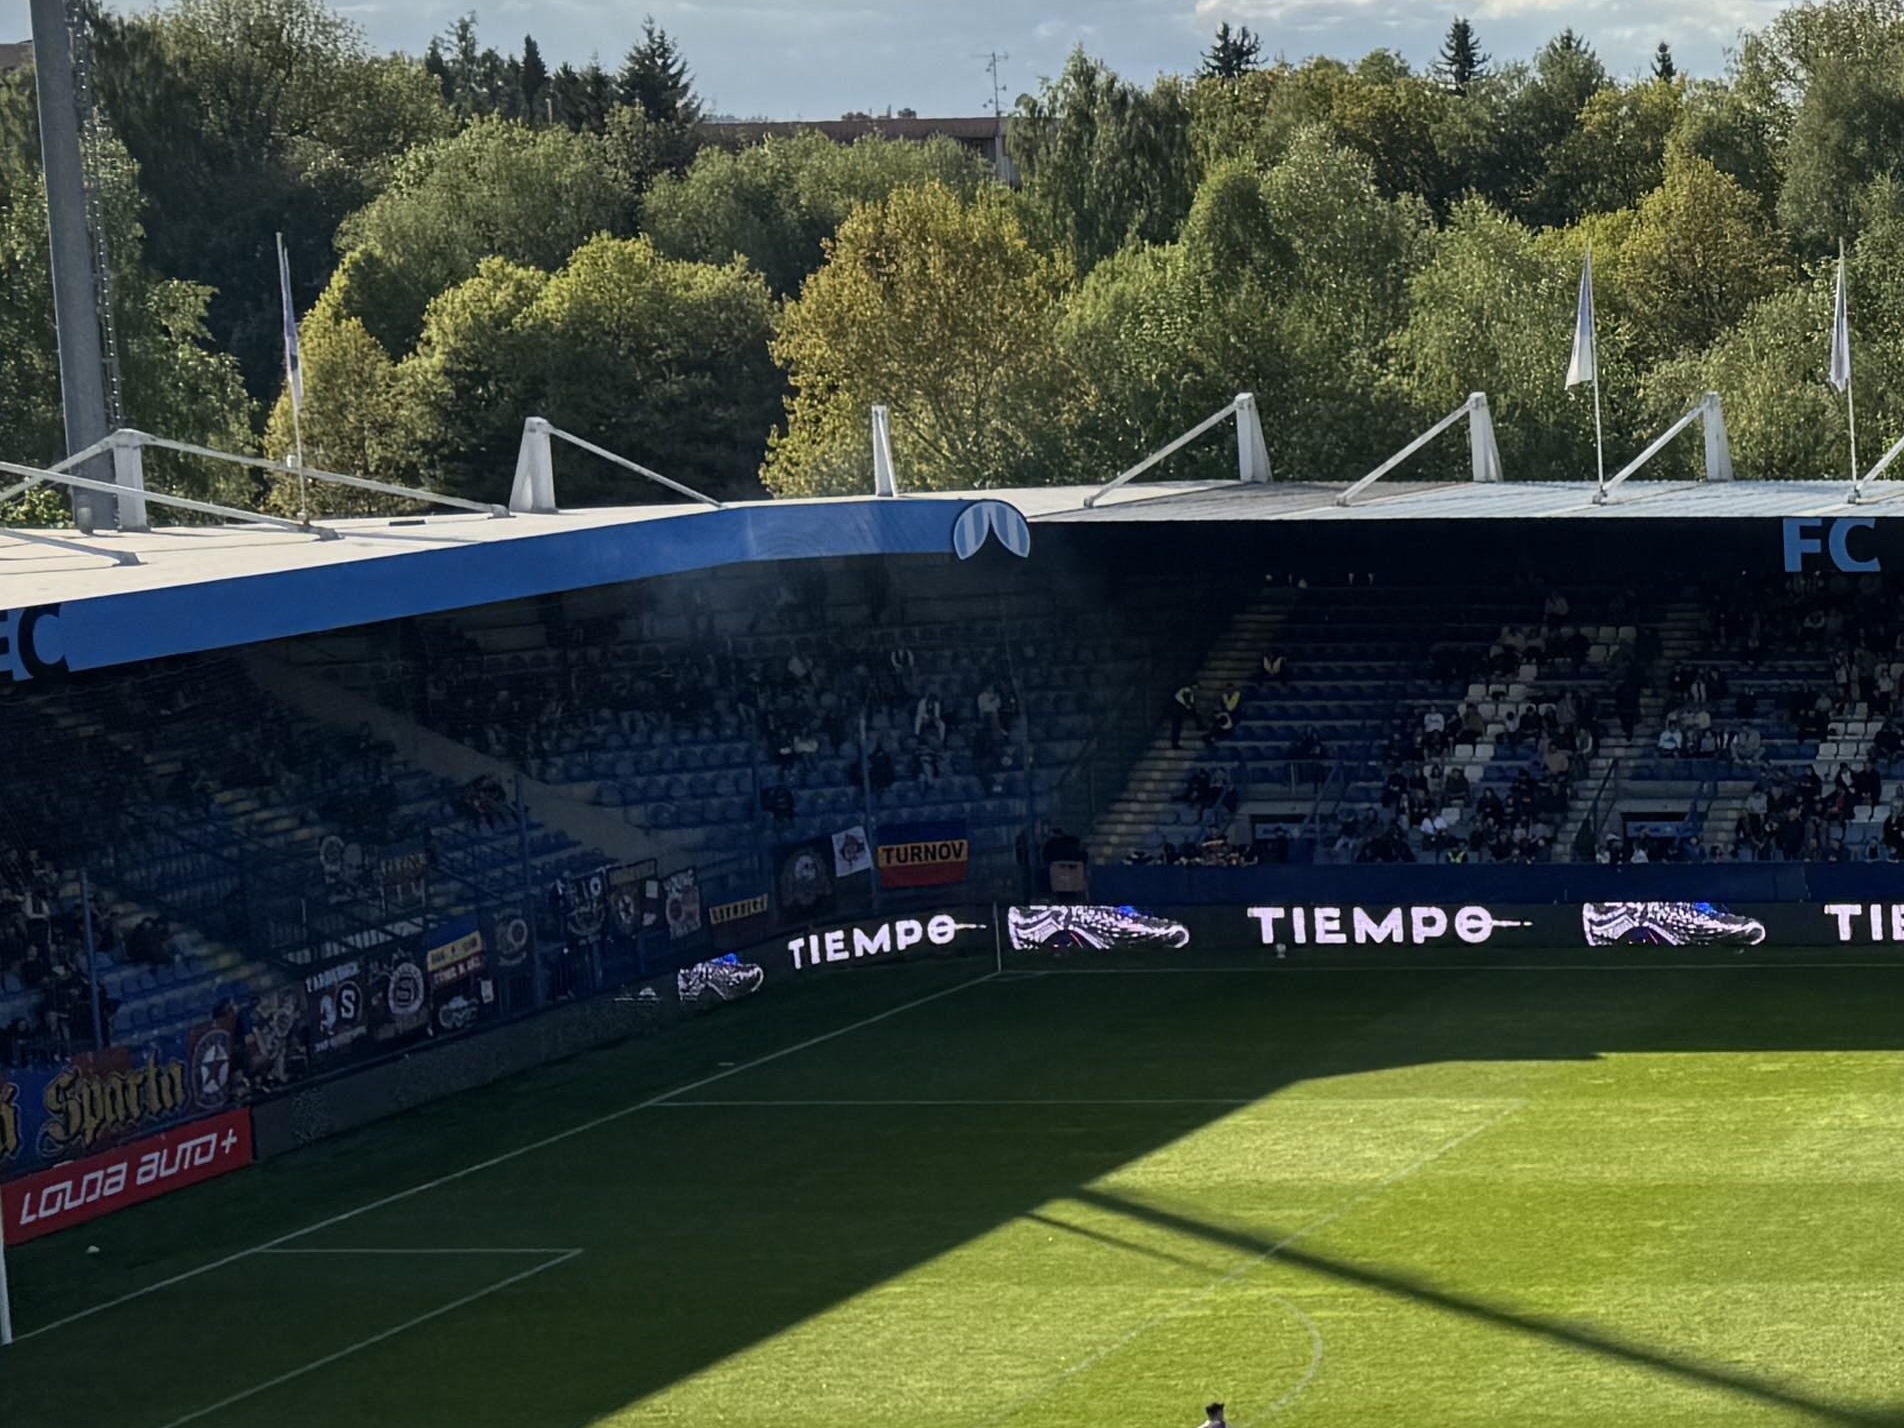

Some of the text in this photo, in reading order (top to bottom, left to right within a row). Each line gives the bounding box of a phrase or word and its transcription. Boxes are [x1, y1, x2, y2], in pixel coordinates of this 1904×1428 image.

[1782, 517, 1881, 571] FC
[882, 842, 964, 865] TURNOV
[788, 915, 956, 969] TIEMPO
[1247, 906, 1494, 944] TIEMPO
